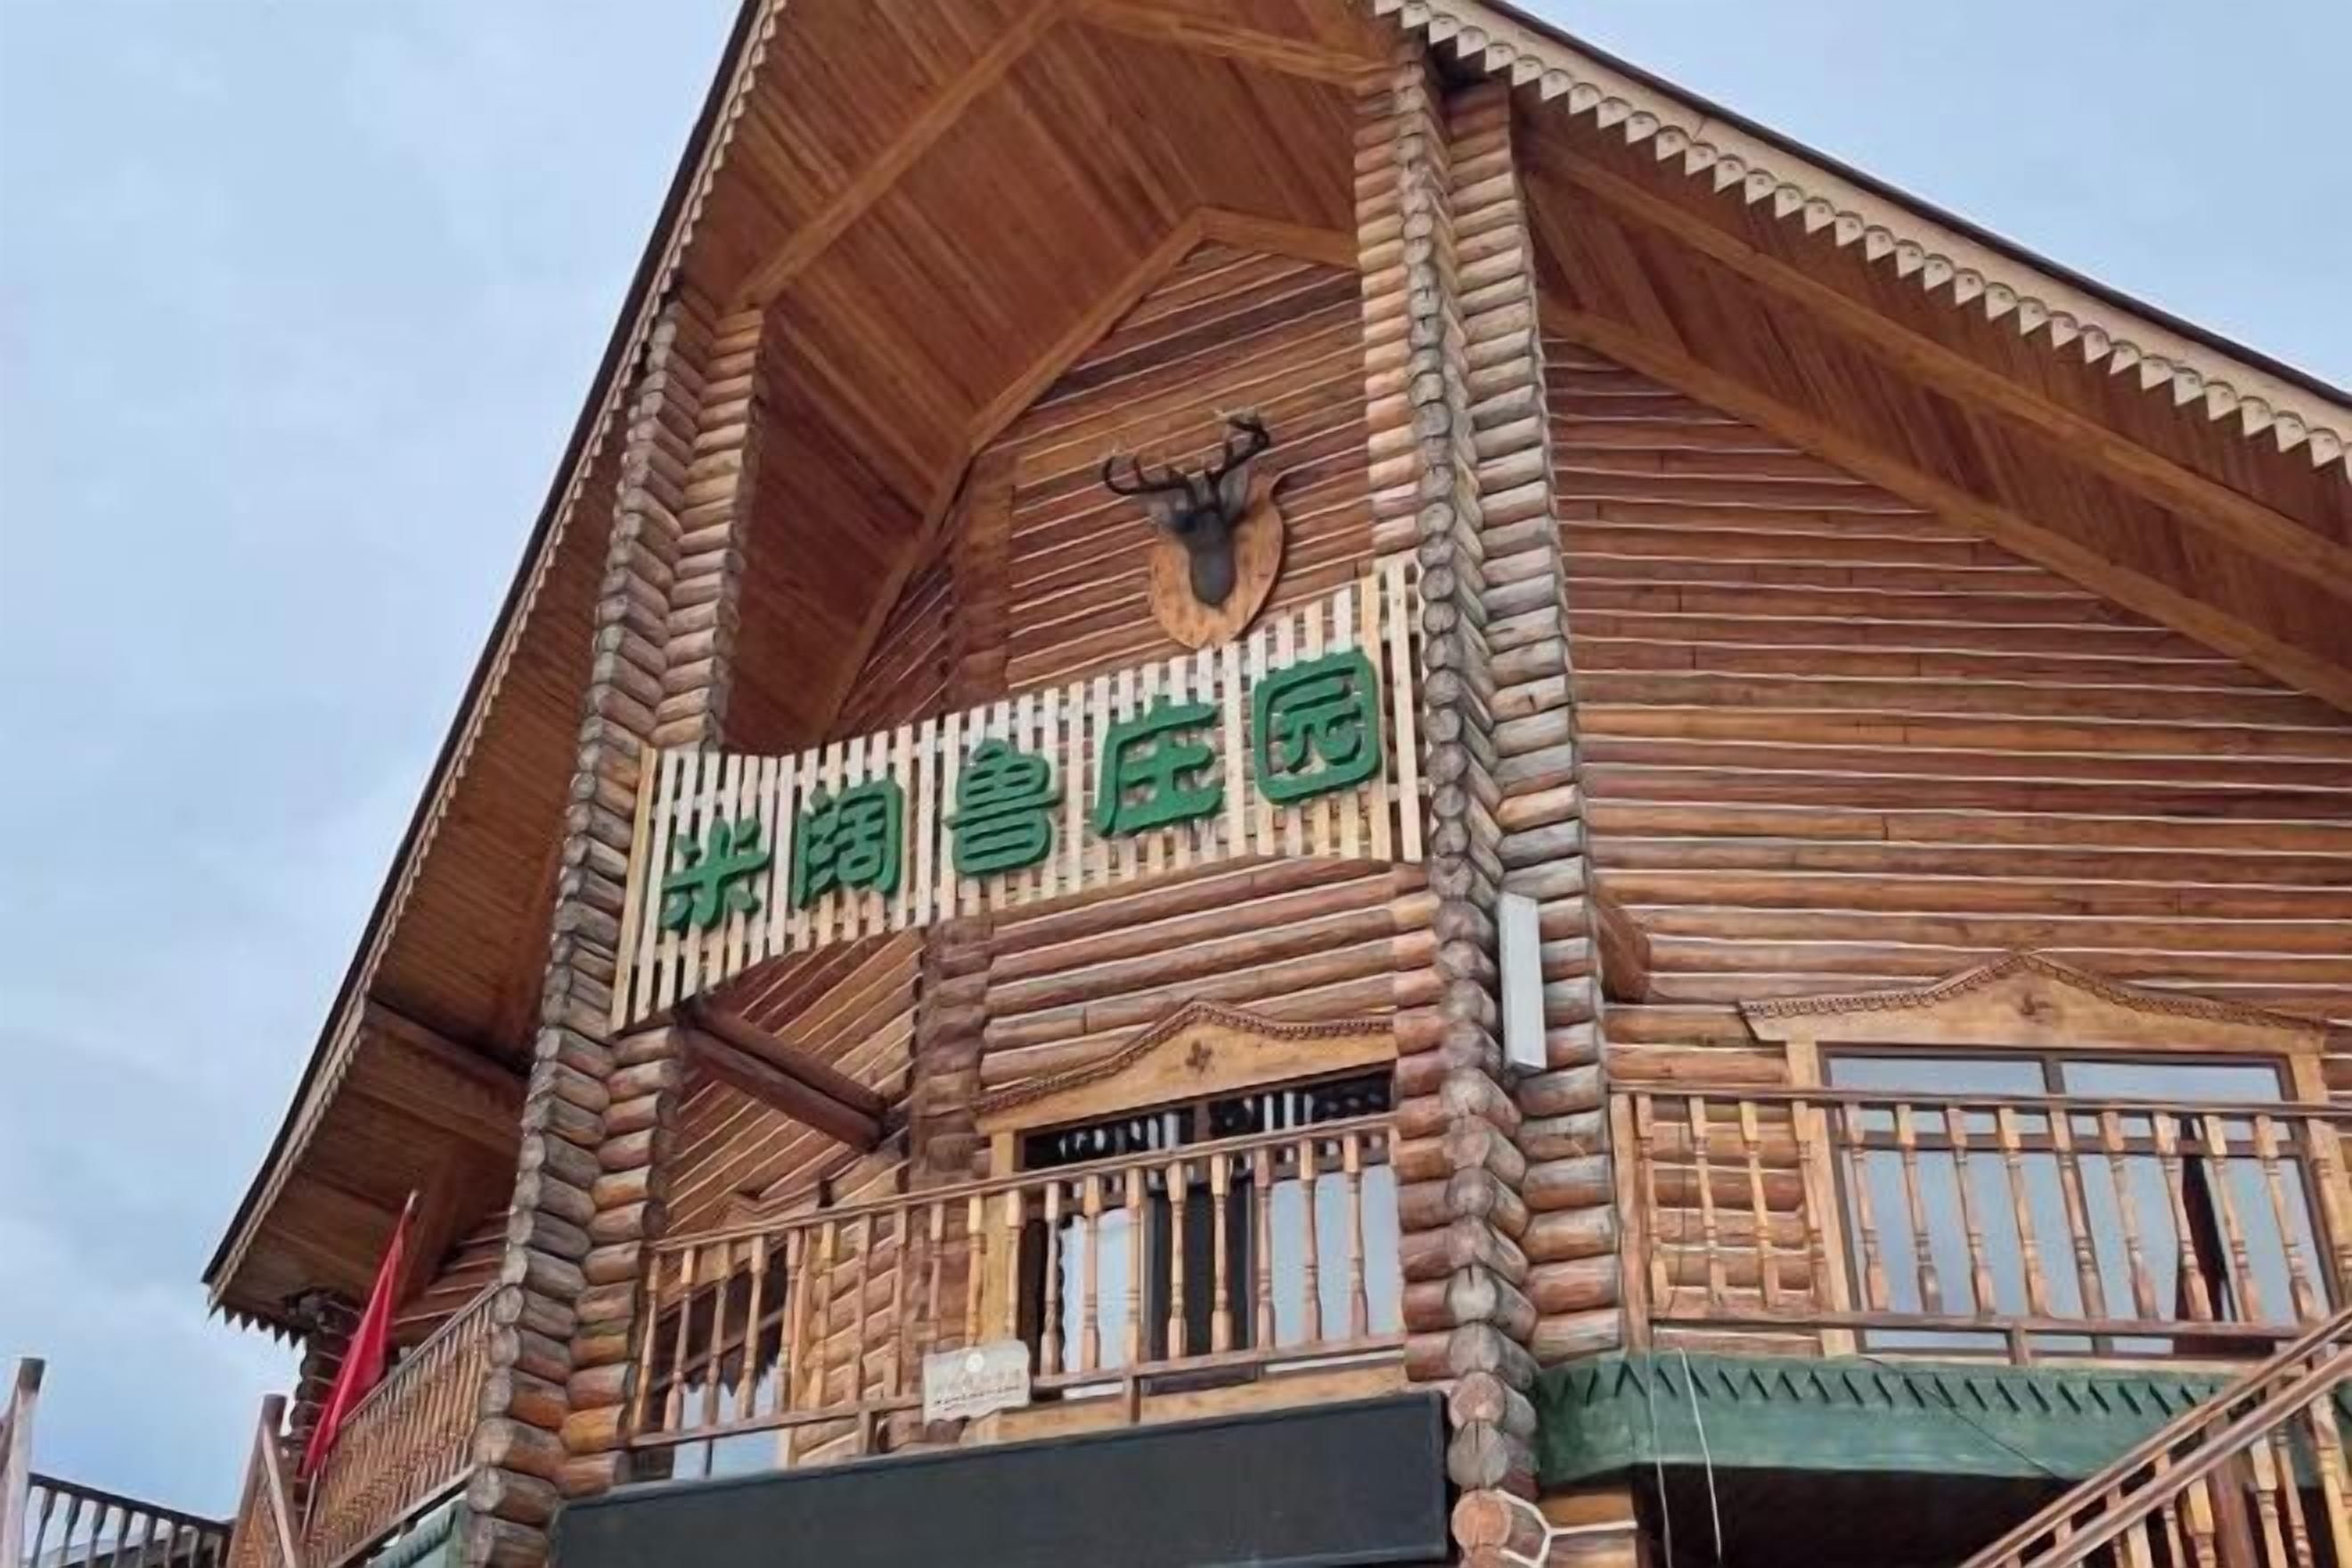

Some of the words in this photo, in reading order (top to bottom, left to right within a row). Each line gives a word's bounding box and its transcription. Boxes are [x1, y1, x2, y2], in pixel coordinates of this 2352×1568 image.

[661, 649, 1381, 930] 米阔鲁庄园
